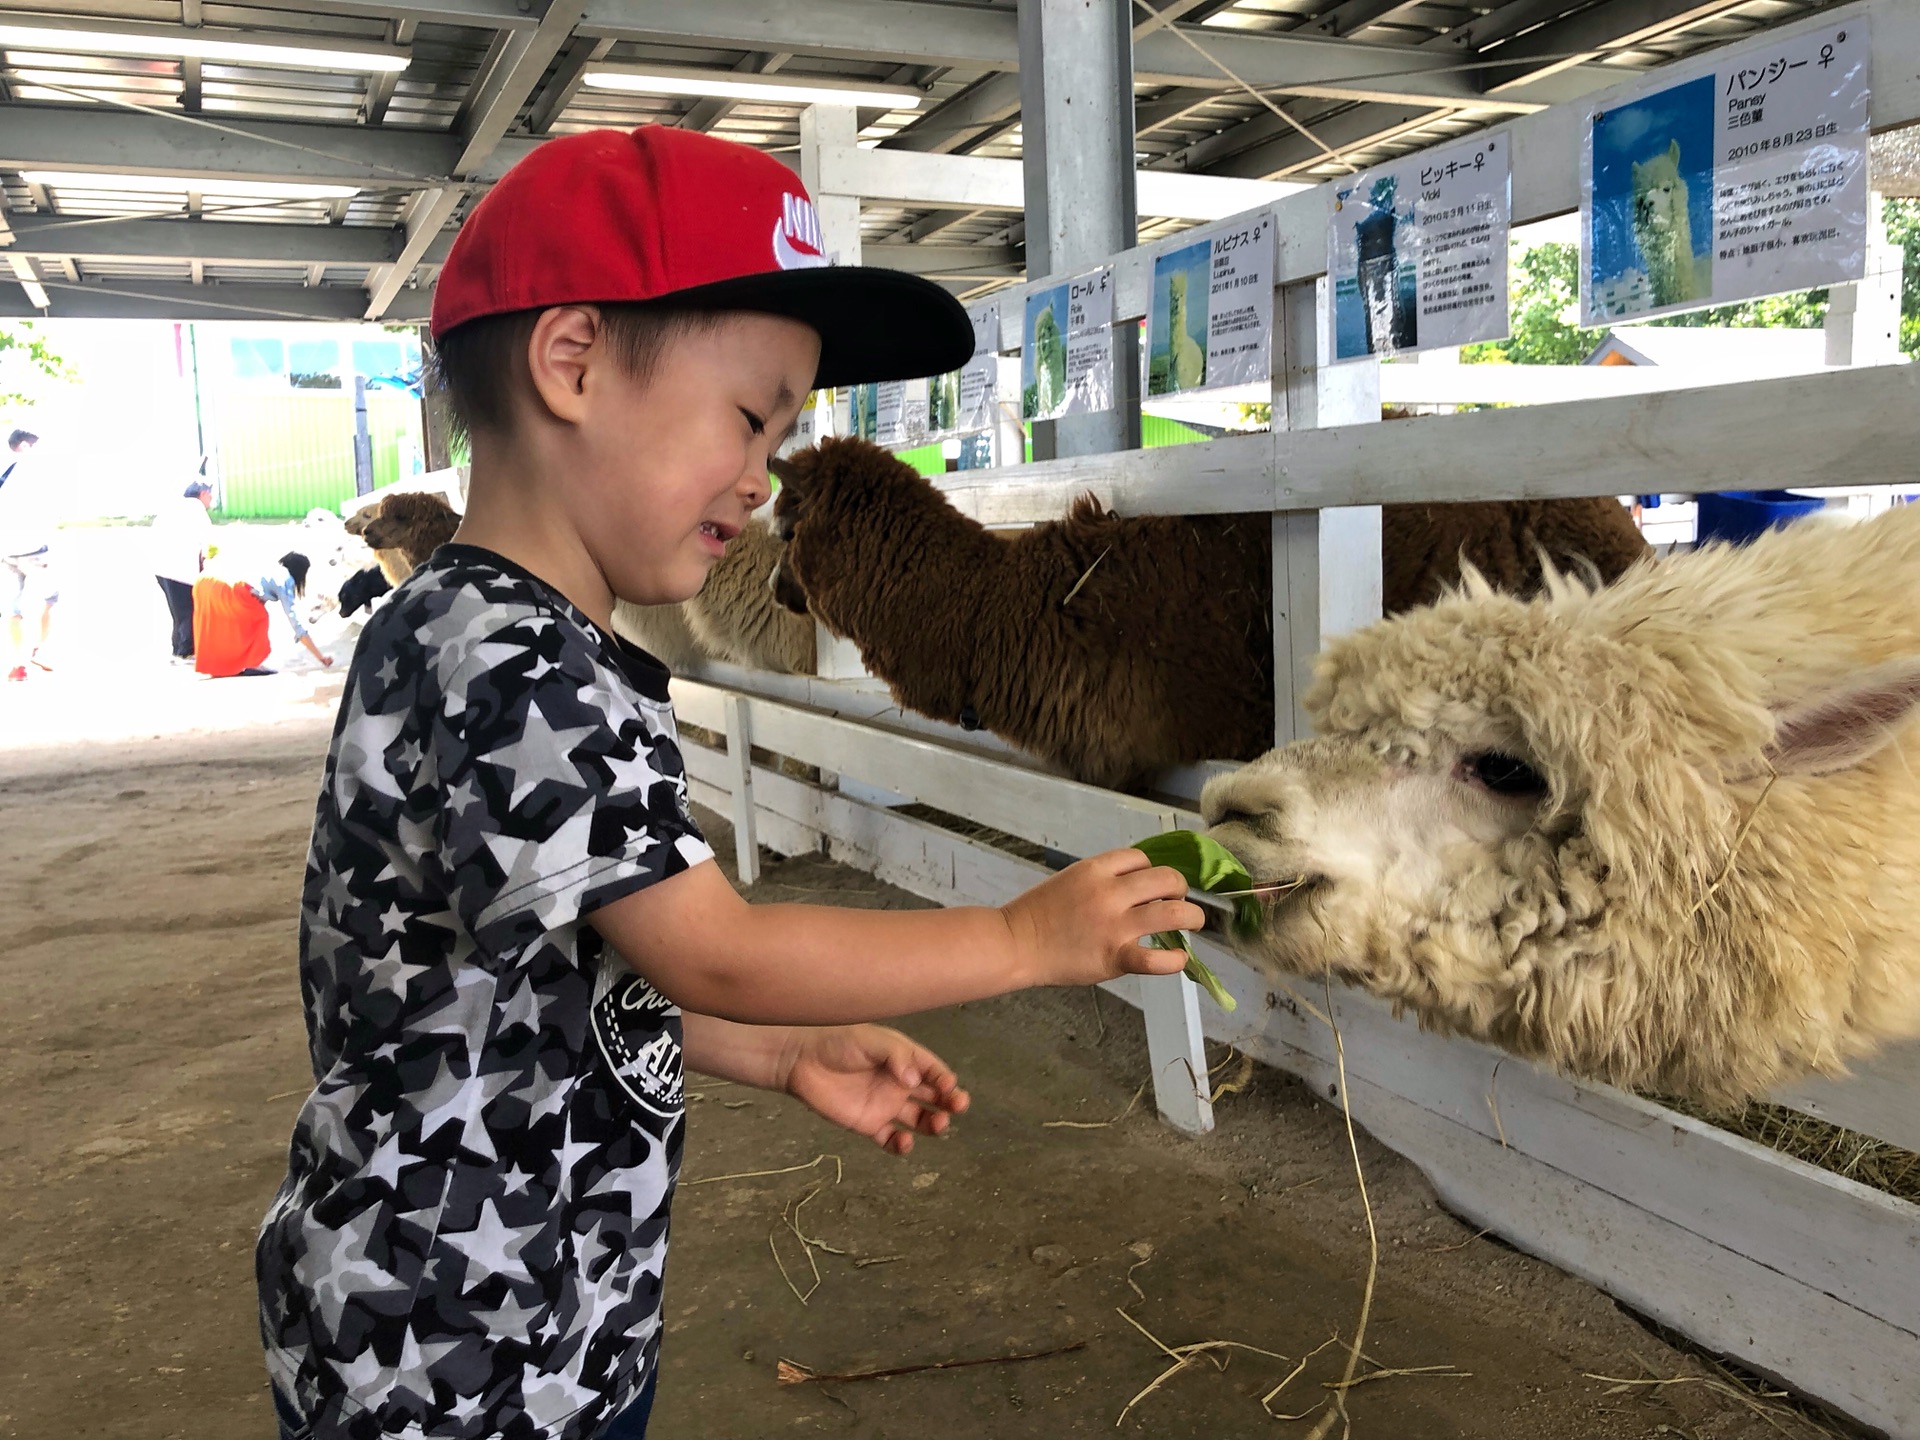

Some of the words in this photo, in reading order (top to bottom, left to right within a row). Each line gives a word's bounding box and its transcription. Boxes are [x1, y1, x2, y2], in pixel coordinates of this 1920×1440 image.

[1726, 57, 1808, 96] パンジー
[1728, 92, 1767, 113] Pansy
[1071, 279, 1095, 300] ロール
